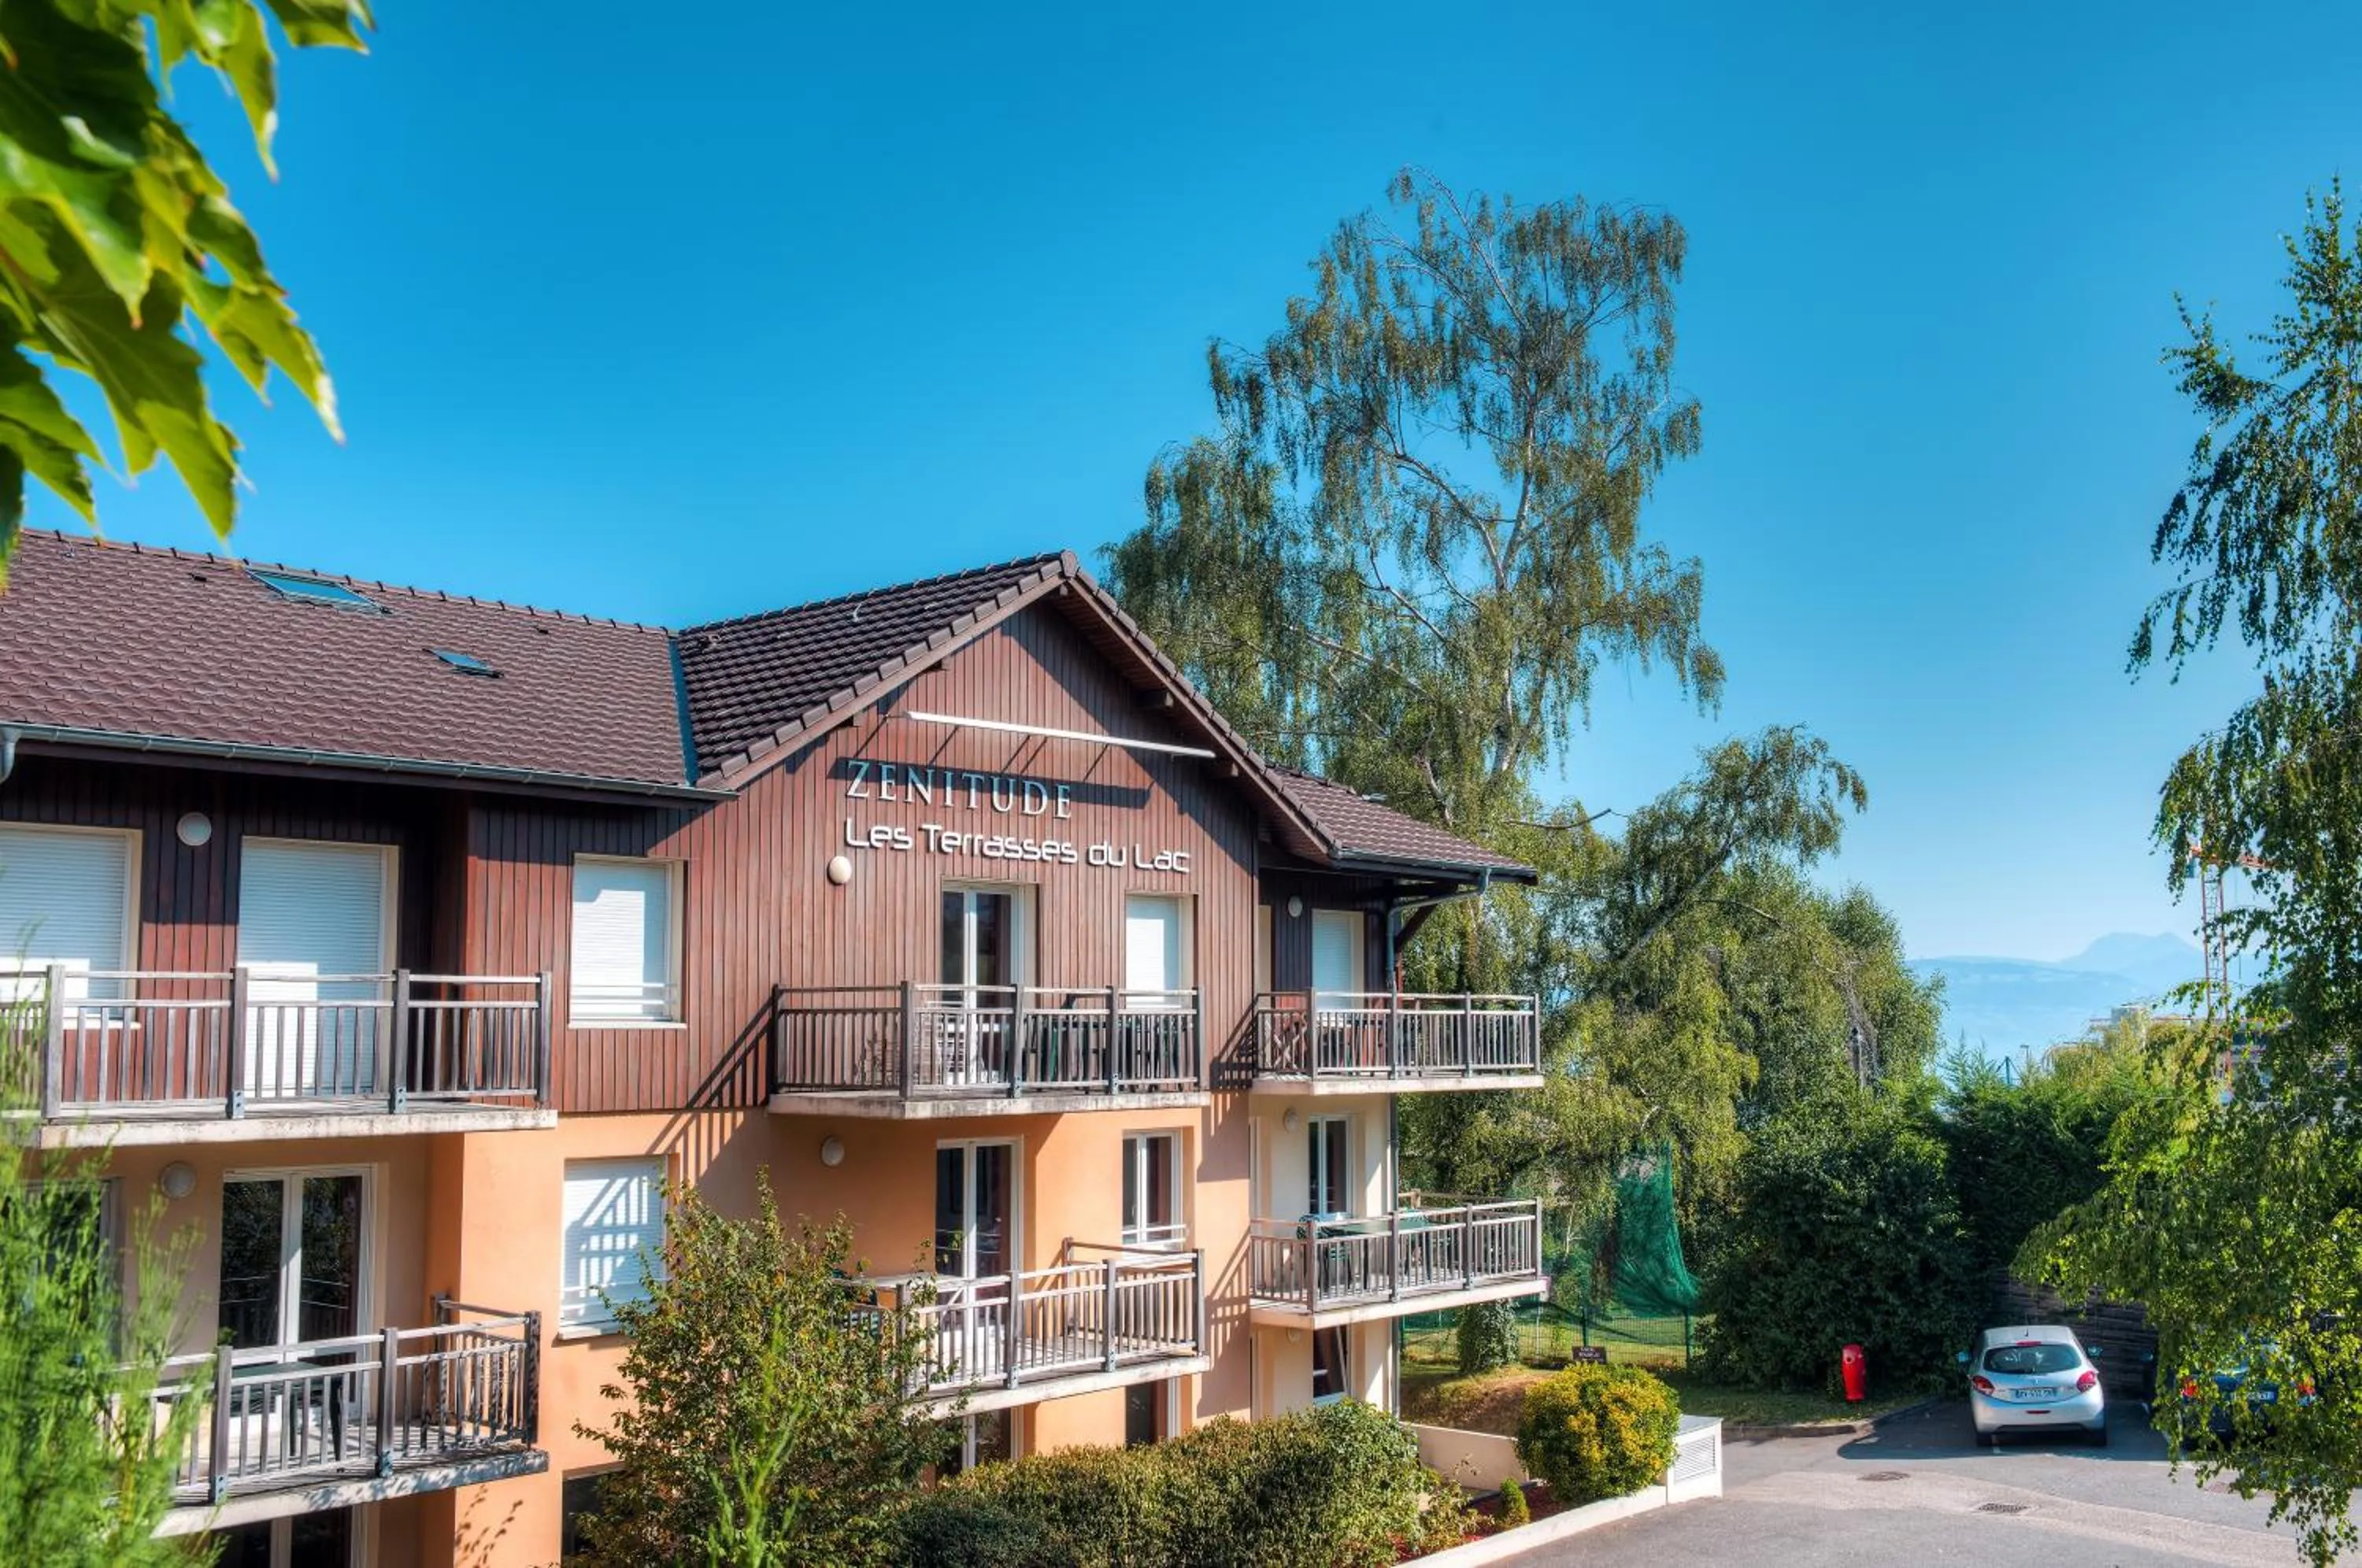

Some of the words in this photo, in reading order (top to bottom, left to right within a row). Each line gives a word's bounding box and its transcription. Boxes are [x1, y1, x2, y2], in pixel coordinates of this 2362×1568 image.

[846, 760, 1072, 819] ZENITUDE
[846, 818, 912, 850] Les
[922, 824, 1078, 864] Terrasses
[1088, 841, 1127, 867] du
[1135, 843, 1191, 873] Lac
